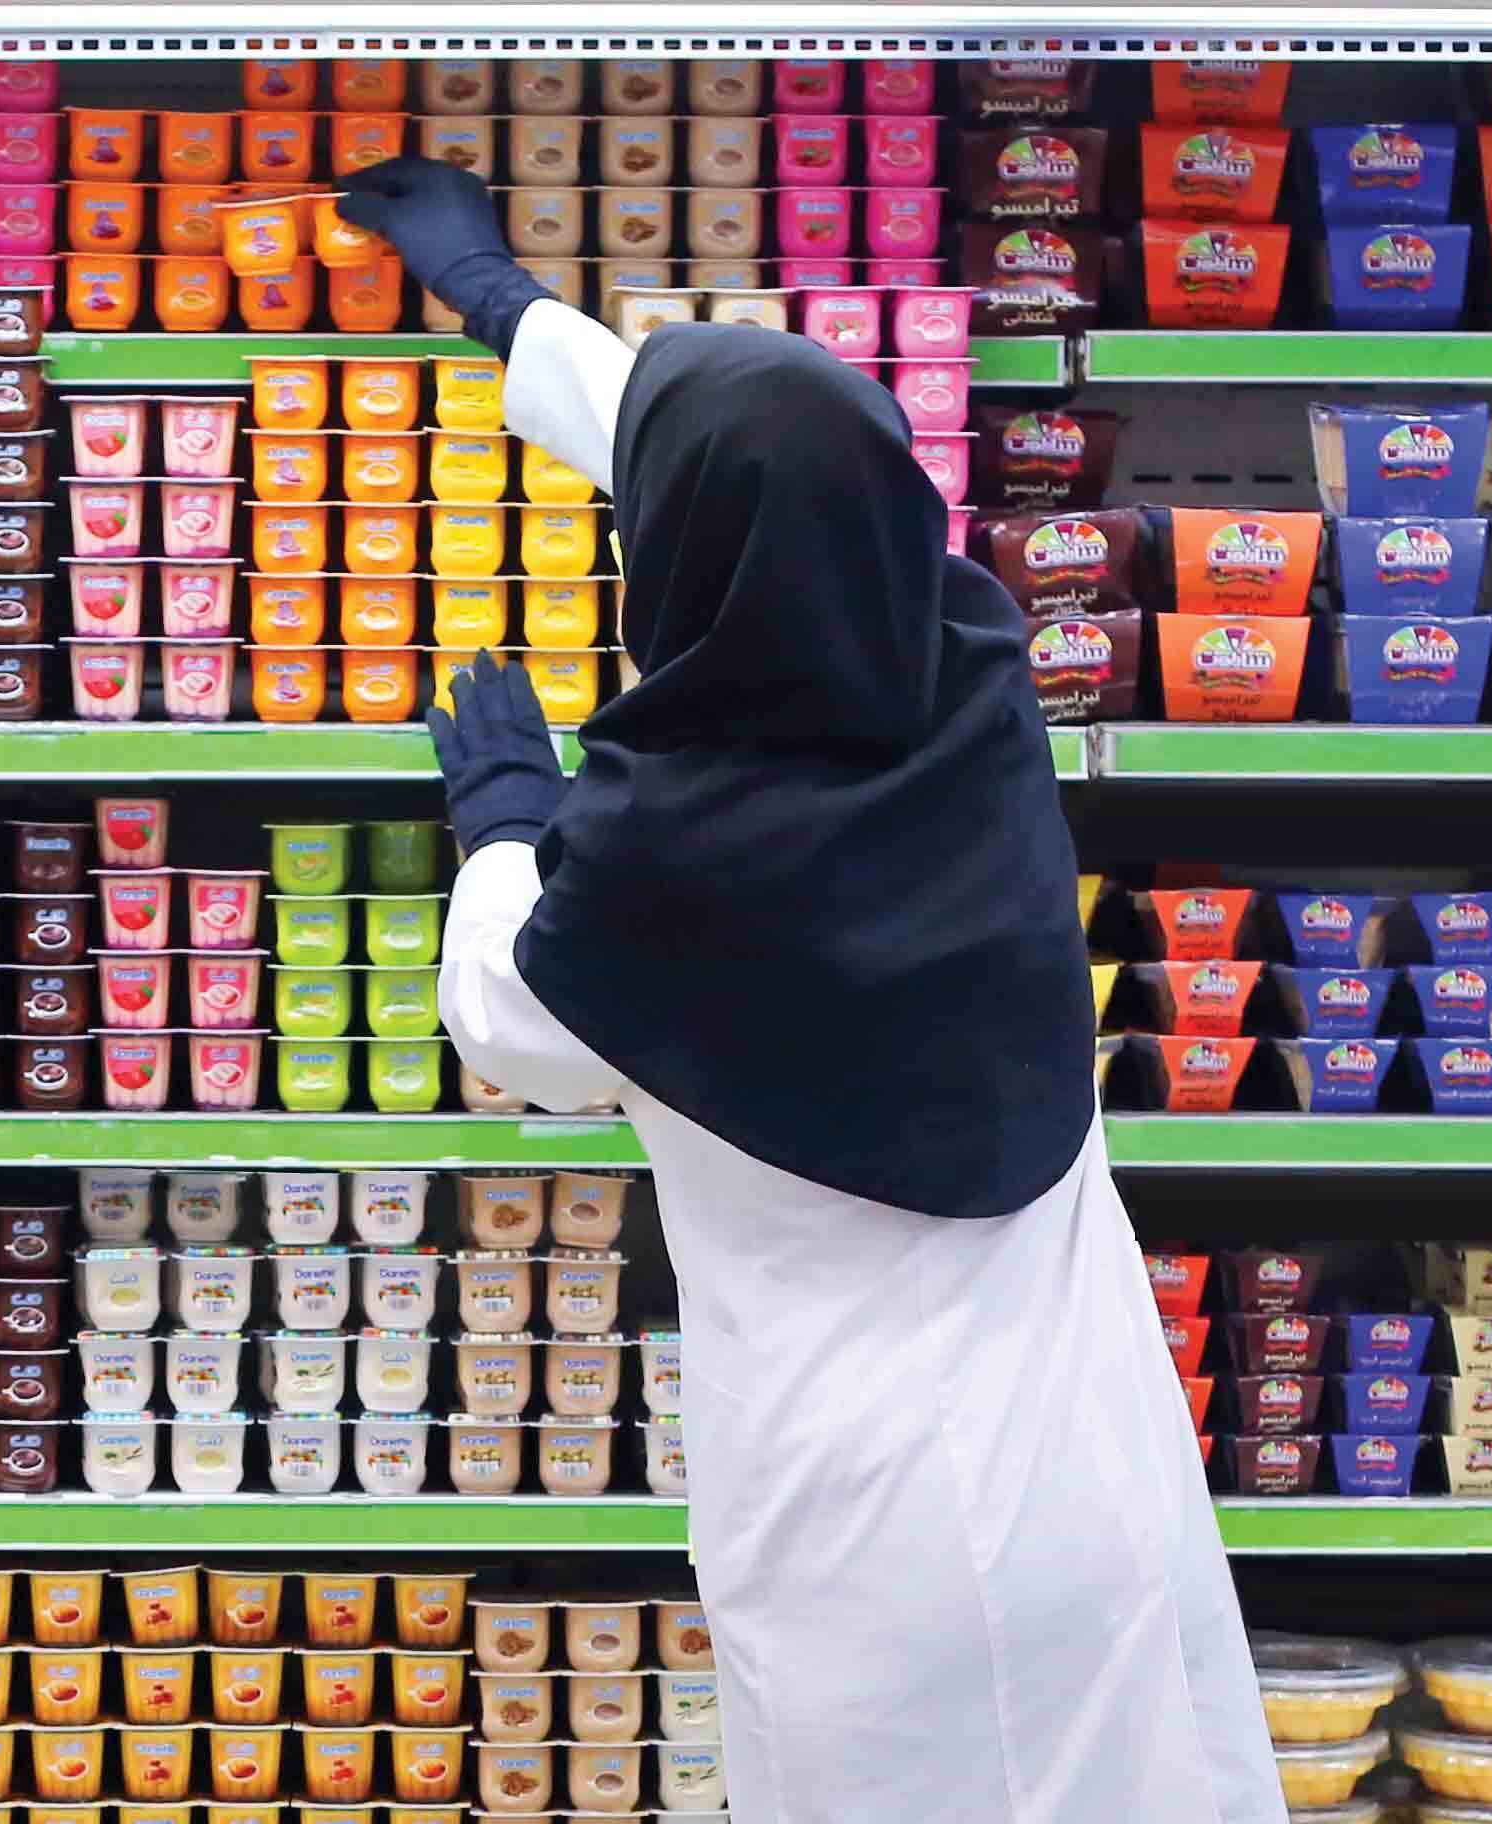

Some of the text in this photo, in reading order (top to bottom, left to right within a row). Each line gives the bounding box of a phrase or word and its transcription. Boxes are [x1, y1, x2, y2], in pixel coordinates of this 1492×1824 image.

[991, 201, 1080, 220] تیرامیسو
[1028, 586, 1098, 610] تیرامیسو
[194, 1271, 236, 1284] Danette
[294, 1268, 336, 1281] Danette
[380, 1268, 420, 1281] Danette
[472, 1271, 513, 1283] Danette
[561, 1271, 602, 1283] Danette
[93, 1353, 135, 1365] Danette
[178, 1353, 220, 1365] Danette
[291, 1351, 332, 1363] Danette
[476, 1357, 516, 1369] Danette
[564, 1357, 604, 1369] Danette
[98, 1435, 140, 1447] Danette
[283, 1435, 324, 1447] Danette
[371, 1436, 412, 1448] Danette
[460, 1435, 500, 1447] Danette
[551, 1435, 592, 1447] Danette
